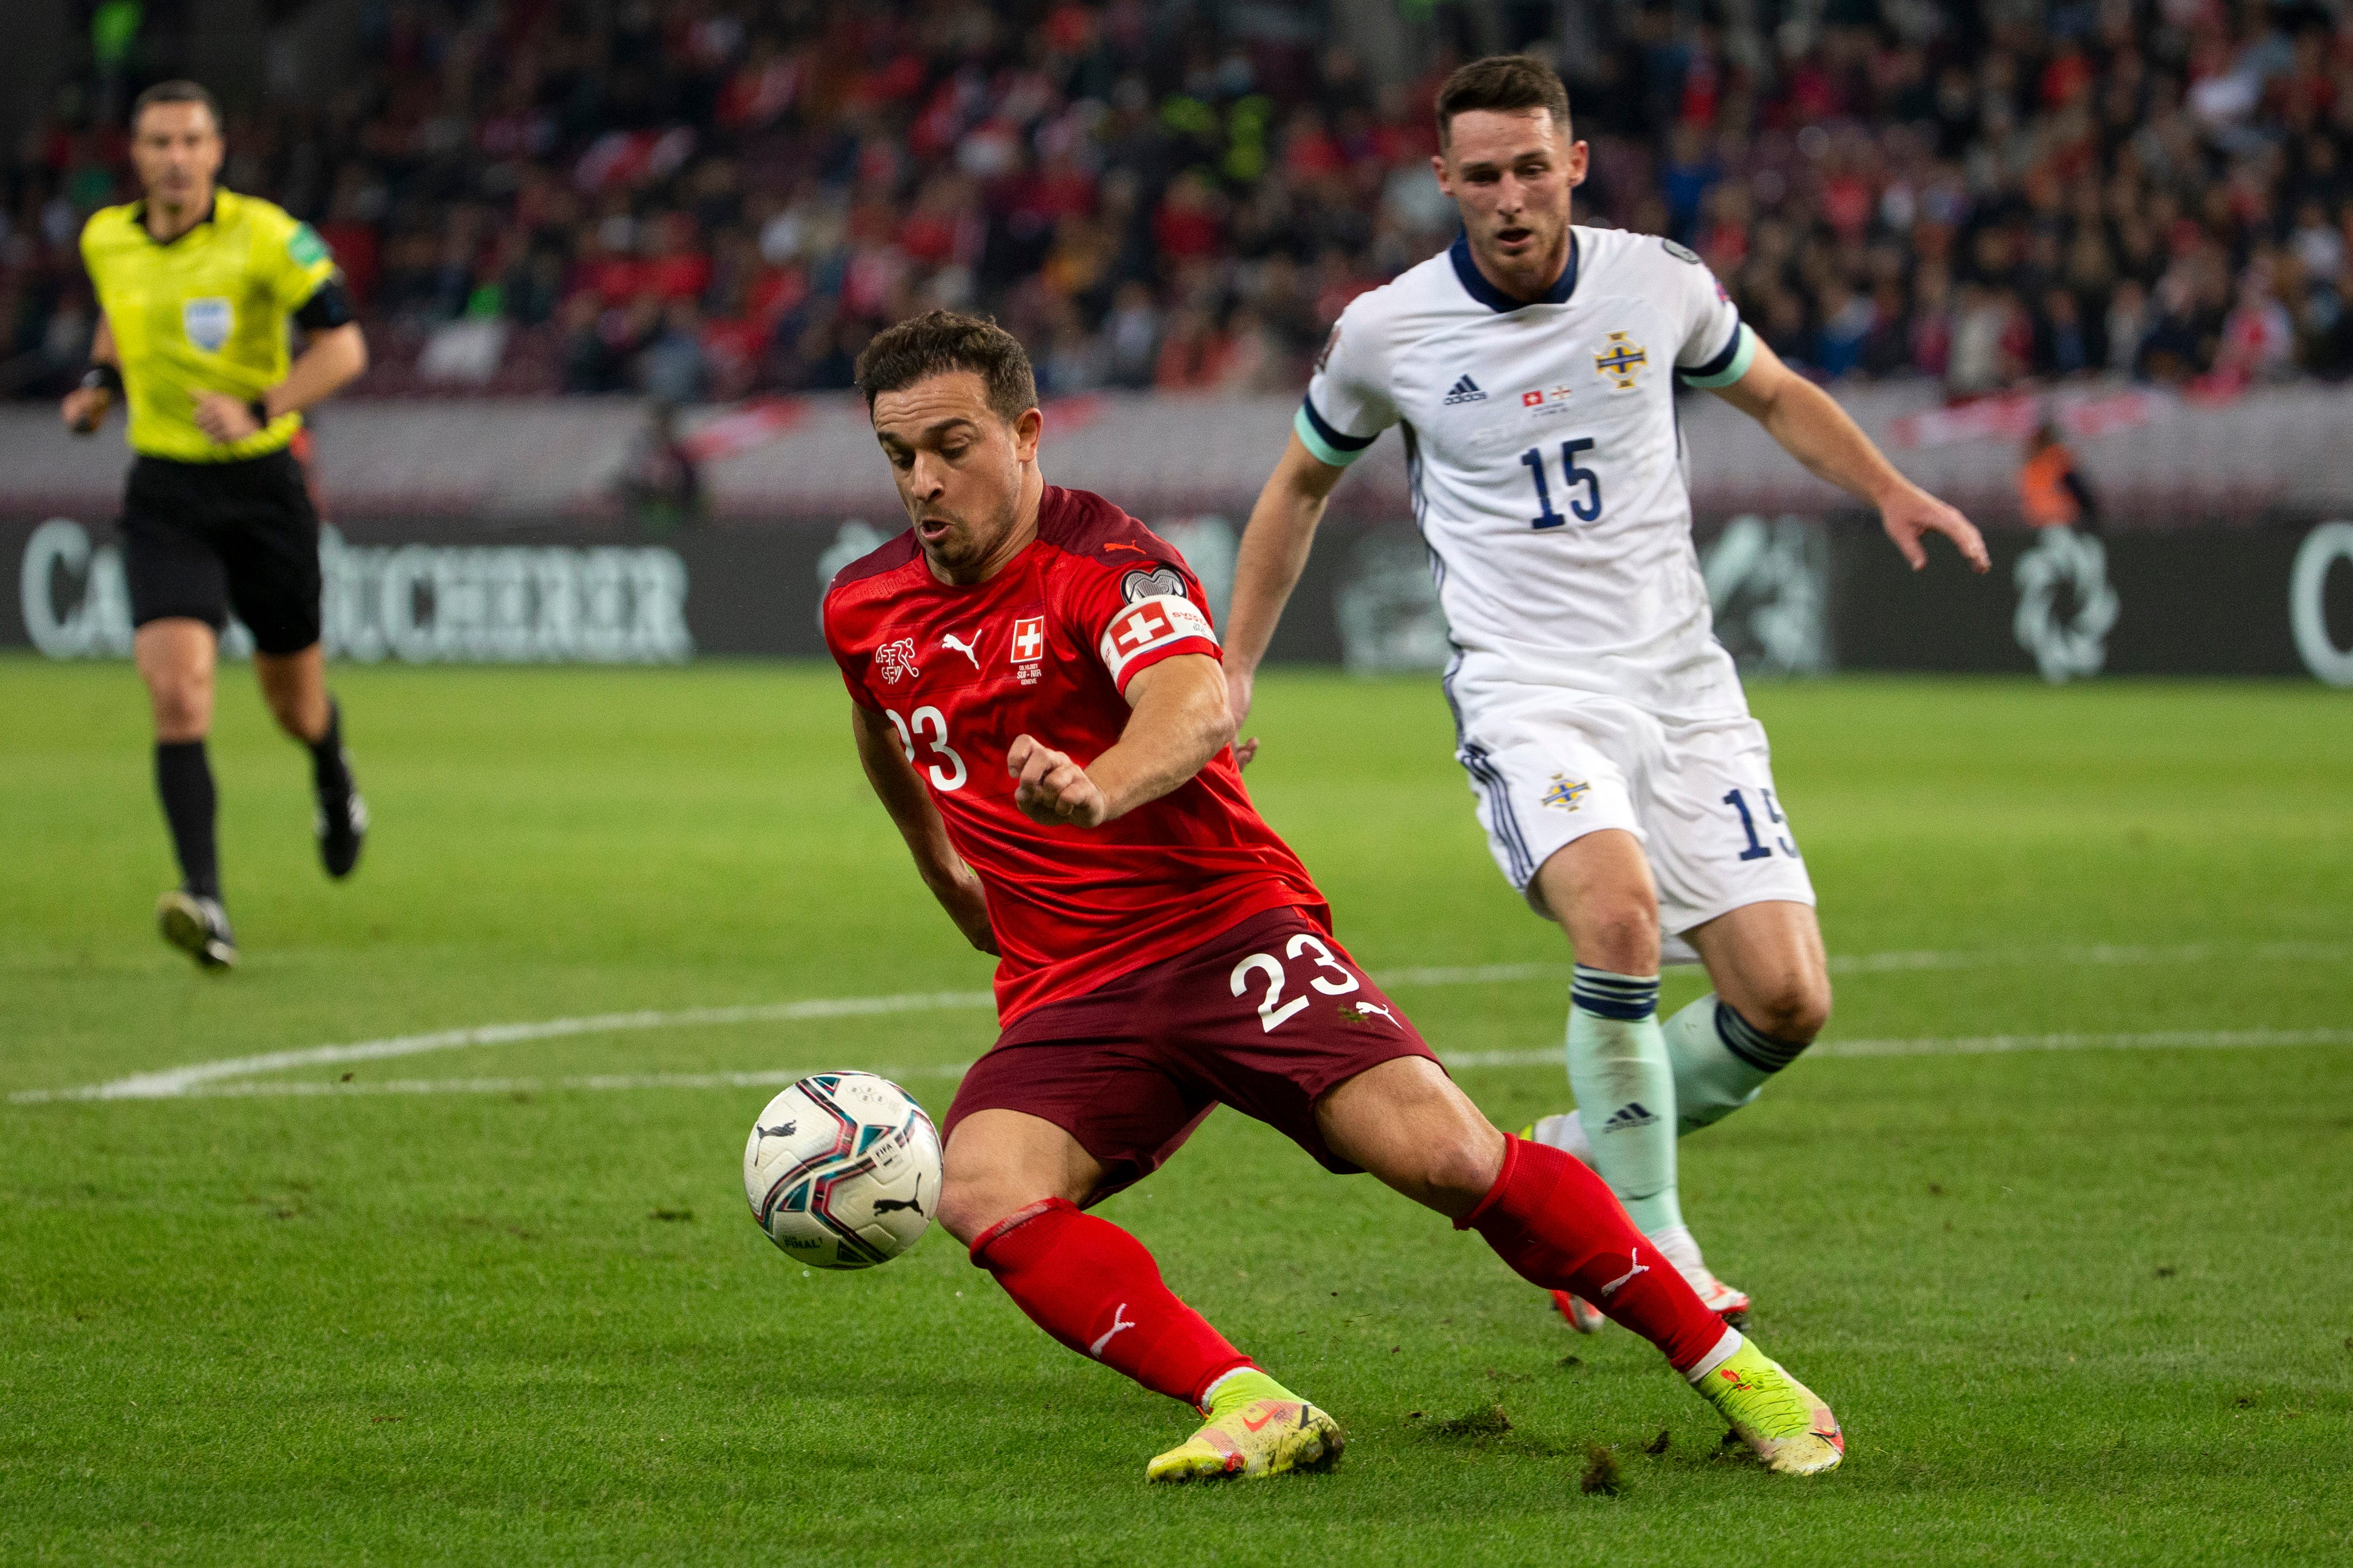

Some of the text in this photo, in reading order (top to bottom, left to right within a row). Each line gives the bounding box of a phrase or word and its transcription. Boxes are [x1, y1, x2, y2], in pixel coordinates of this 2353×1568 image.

[1521, 437, 1601, 529] 15
[1017, 671, 1026, 679] SUI
[1030, 669, 1042, 678] NIR
[1230, 933, 1360, 1034] 23
